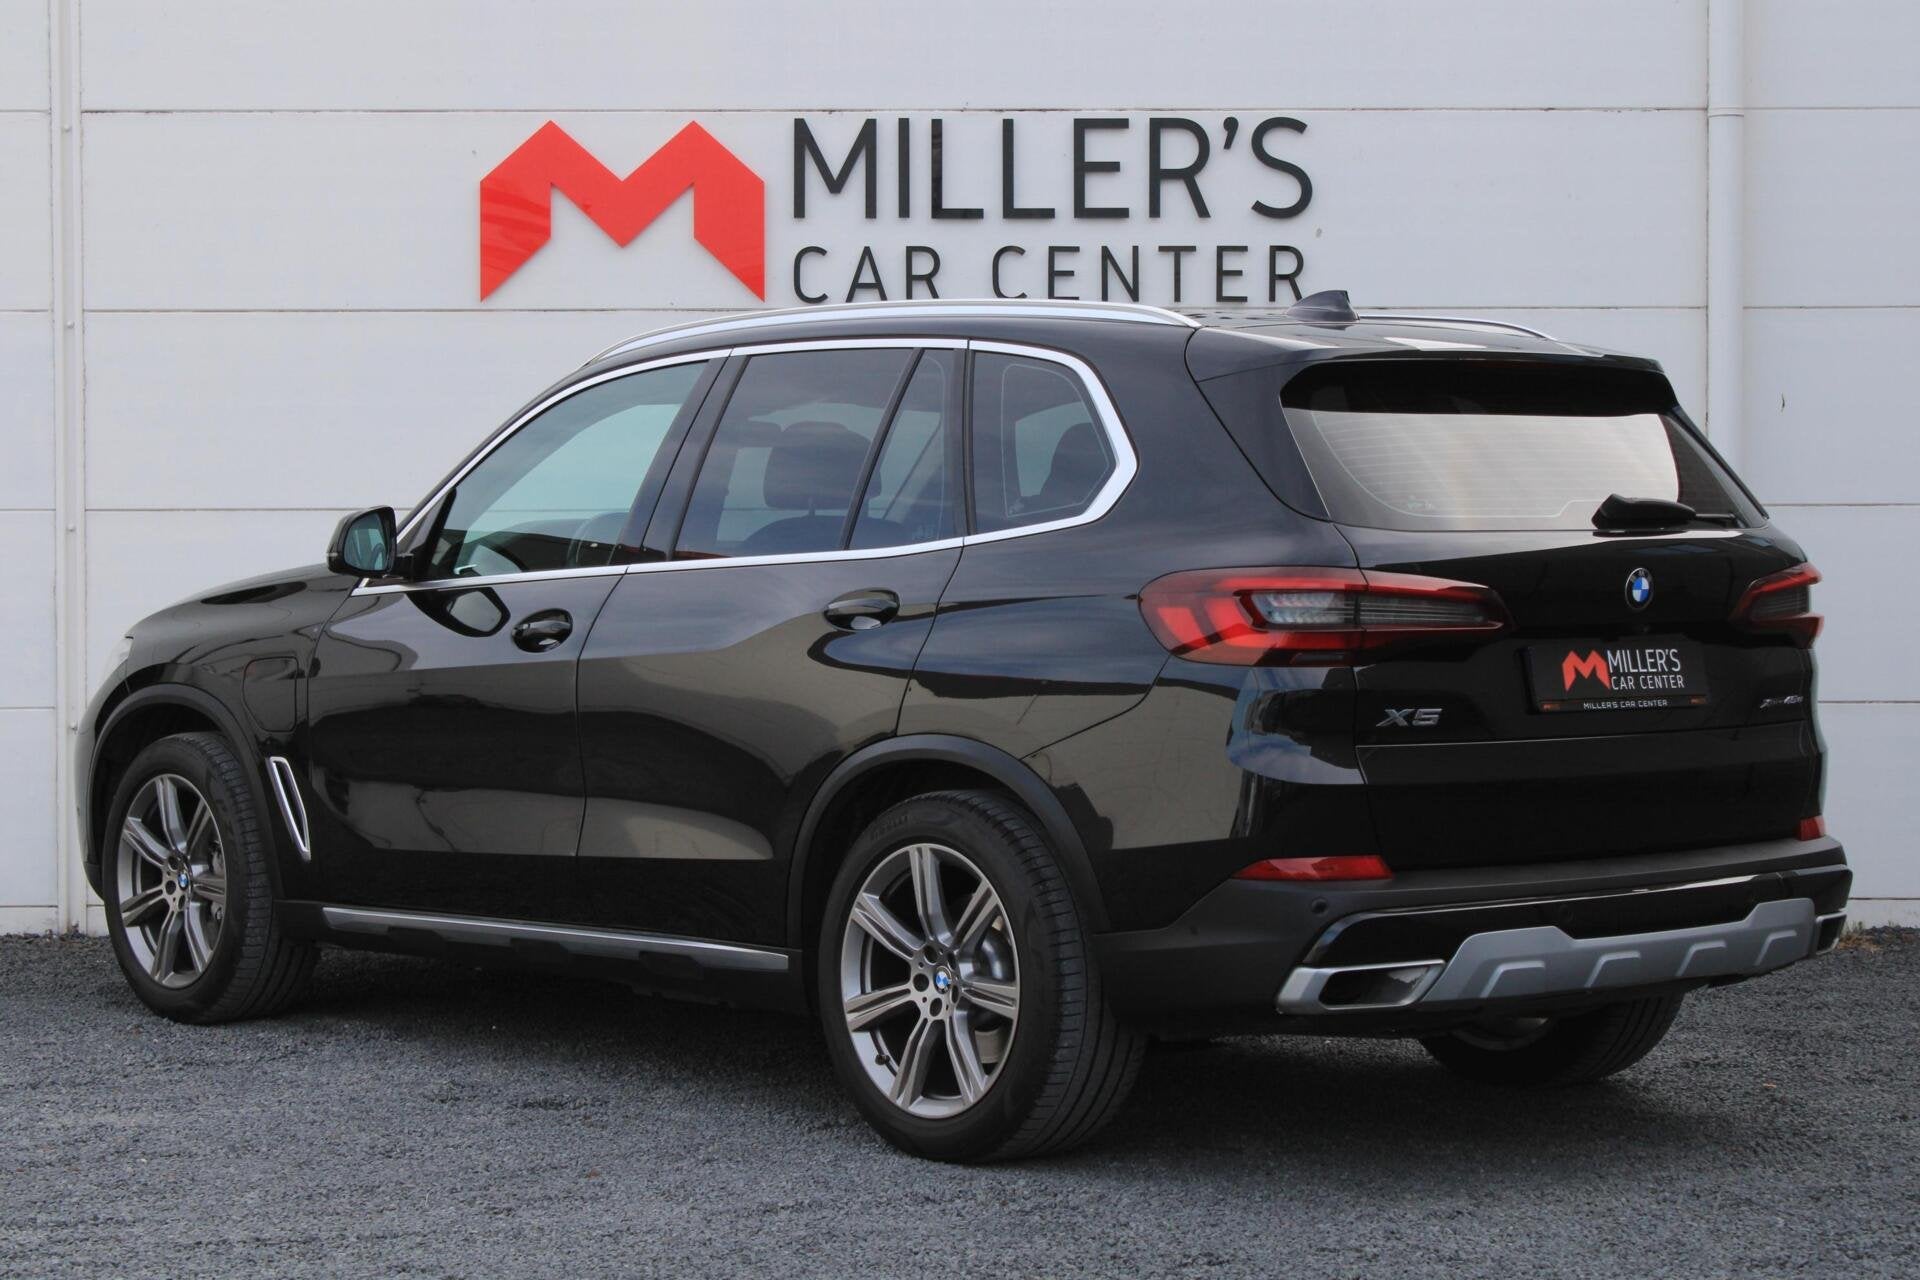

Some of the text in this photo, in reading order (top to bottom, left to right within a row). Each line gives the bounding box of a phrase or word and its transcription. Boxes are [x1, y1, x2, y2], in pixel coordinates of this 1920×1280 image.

[794, 116, 1313, 220] MILLER'S
[793, 245, 1305, 302] CAR CENTER
[1607, 648, 1682, 673] MILLER'S
[1611, 674, 1685, 690] CAR CENTER
[1620, 700, 1636, 709] CAR
[1638, 699, 1668, 708] CENTER
[1376, 708, 1443, 727] X5
